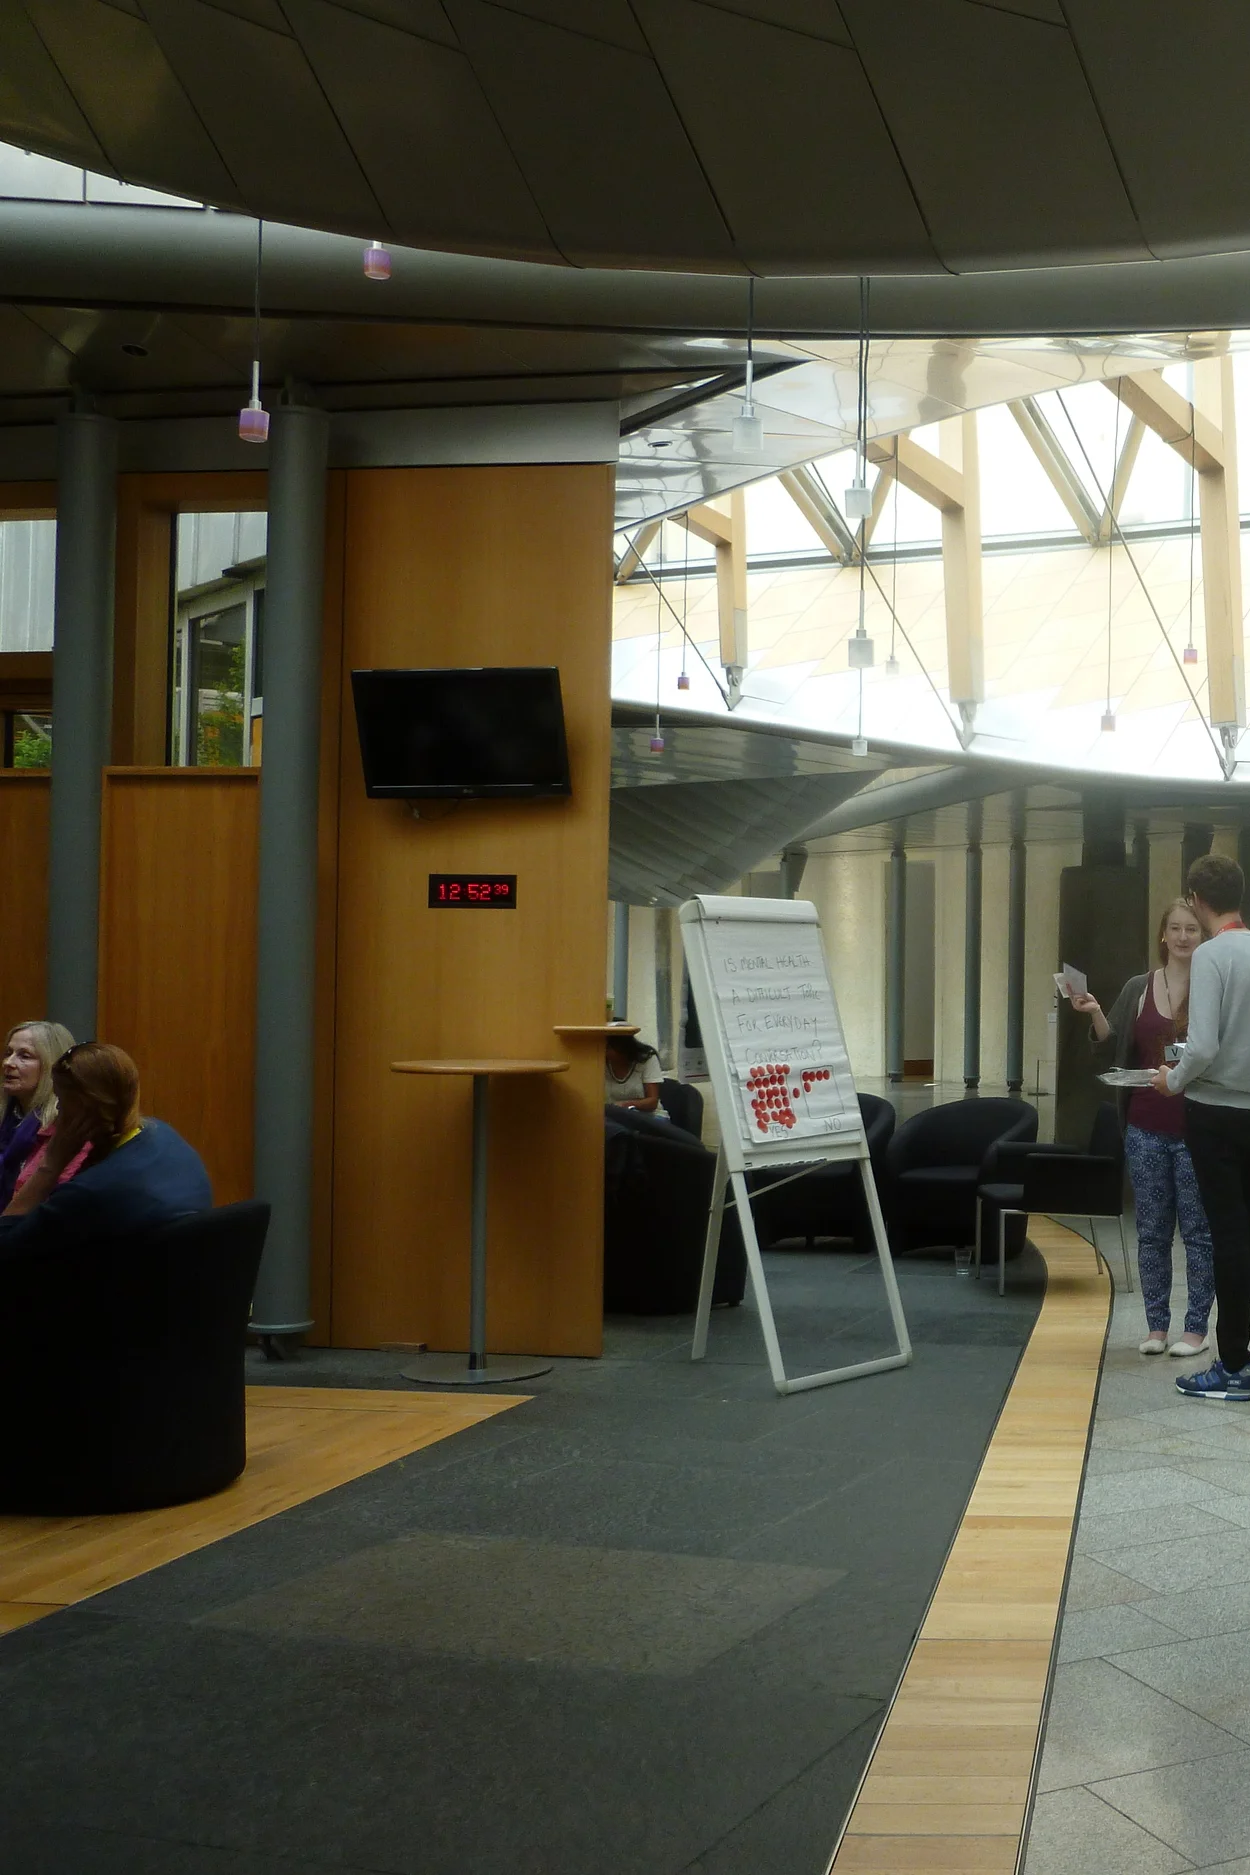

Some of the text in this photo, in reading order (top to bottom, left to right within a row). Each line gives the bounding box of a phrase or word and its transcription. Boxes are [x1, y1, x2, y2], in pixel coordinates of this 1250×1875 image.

[494, 884, 509, 895] 39
[724, 954, 812, 973] IS MENTAL HEALTH
[732, 988, 741, 1005] A
[747, 986, 790, 1003] DIFFICULT
[736, 1013, 817, 1038] FOR EVERYDAY
[1171, 1048, 1178, 1057] V
[768, 1124, 790, 1138] YES
[824, 1119, 842, 1132] NO
